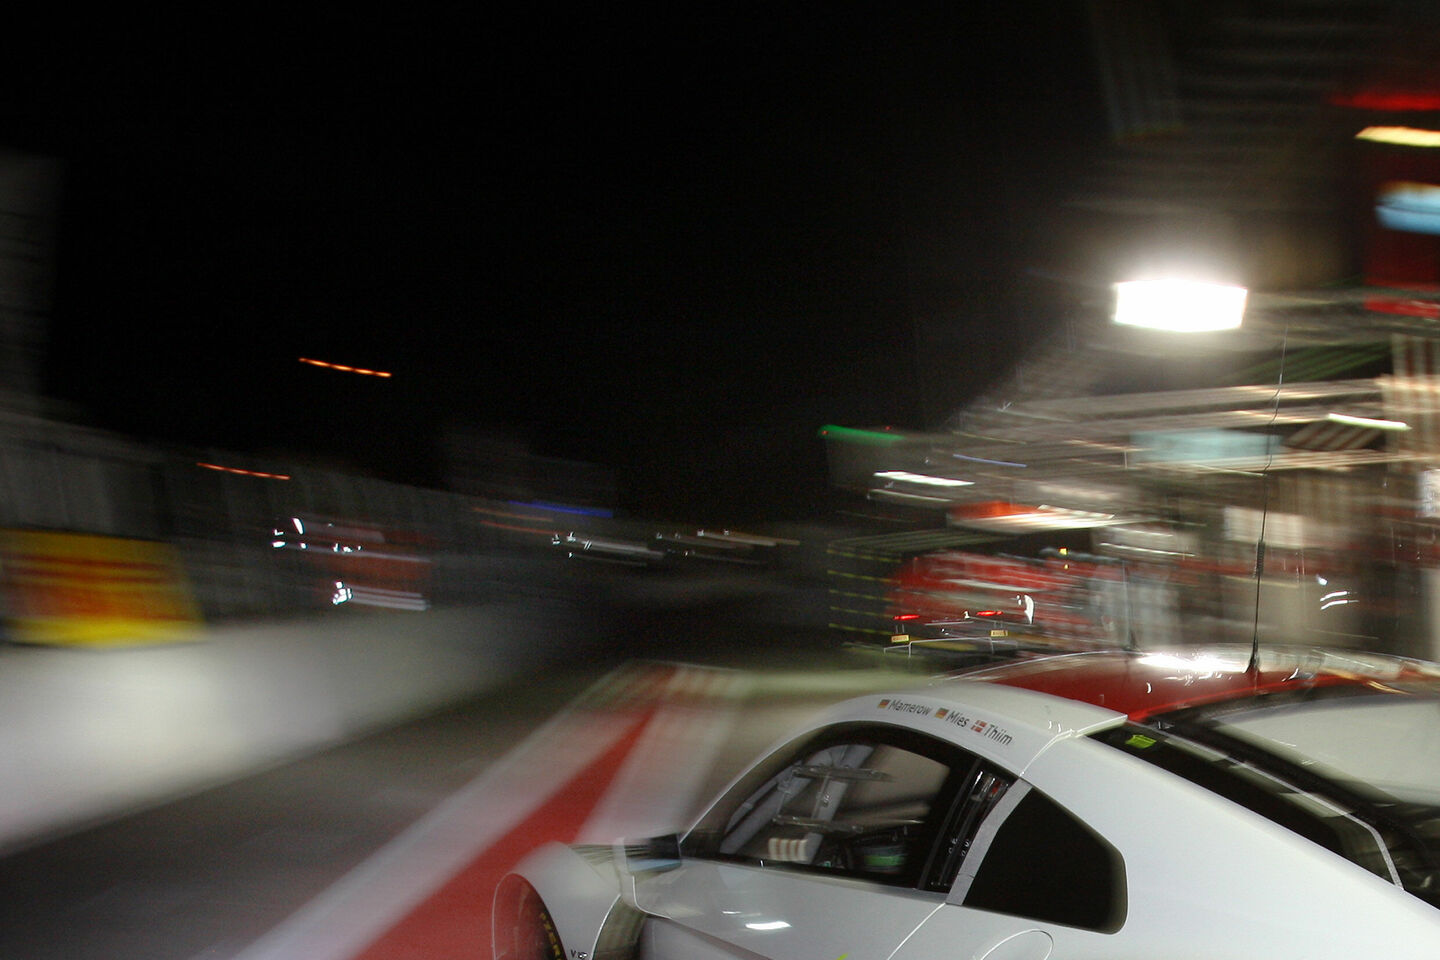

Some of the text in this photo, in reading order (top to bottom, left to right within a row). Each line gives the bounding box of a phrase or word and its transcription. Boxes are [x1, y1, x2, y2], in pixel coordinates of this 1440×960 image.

[888, 699, 1013, 746] Mamerow Mies Thiim
